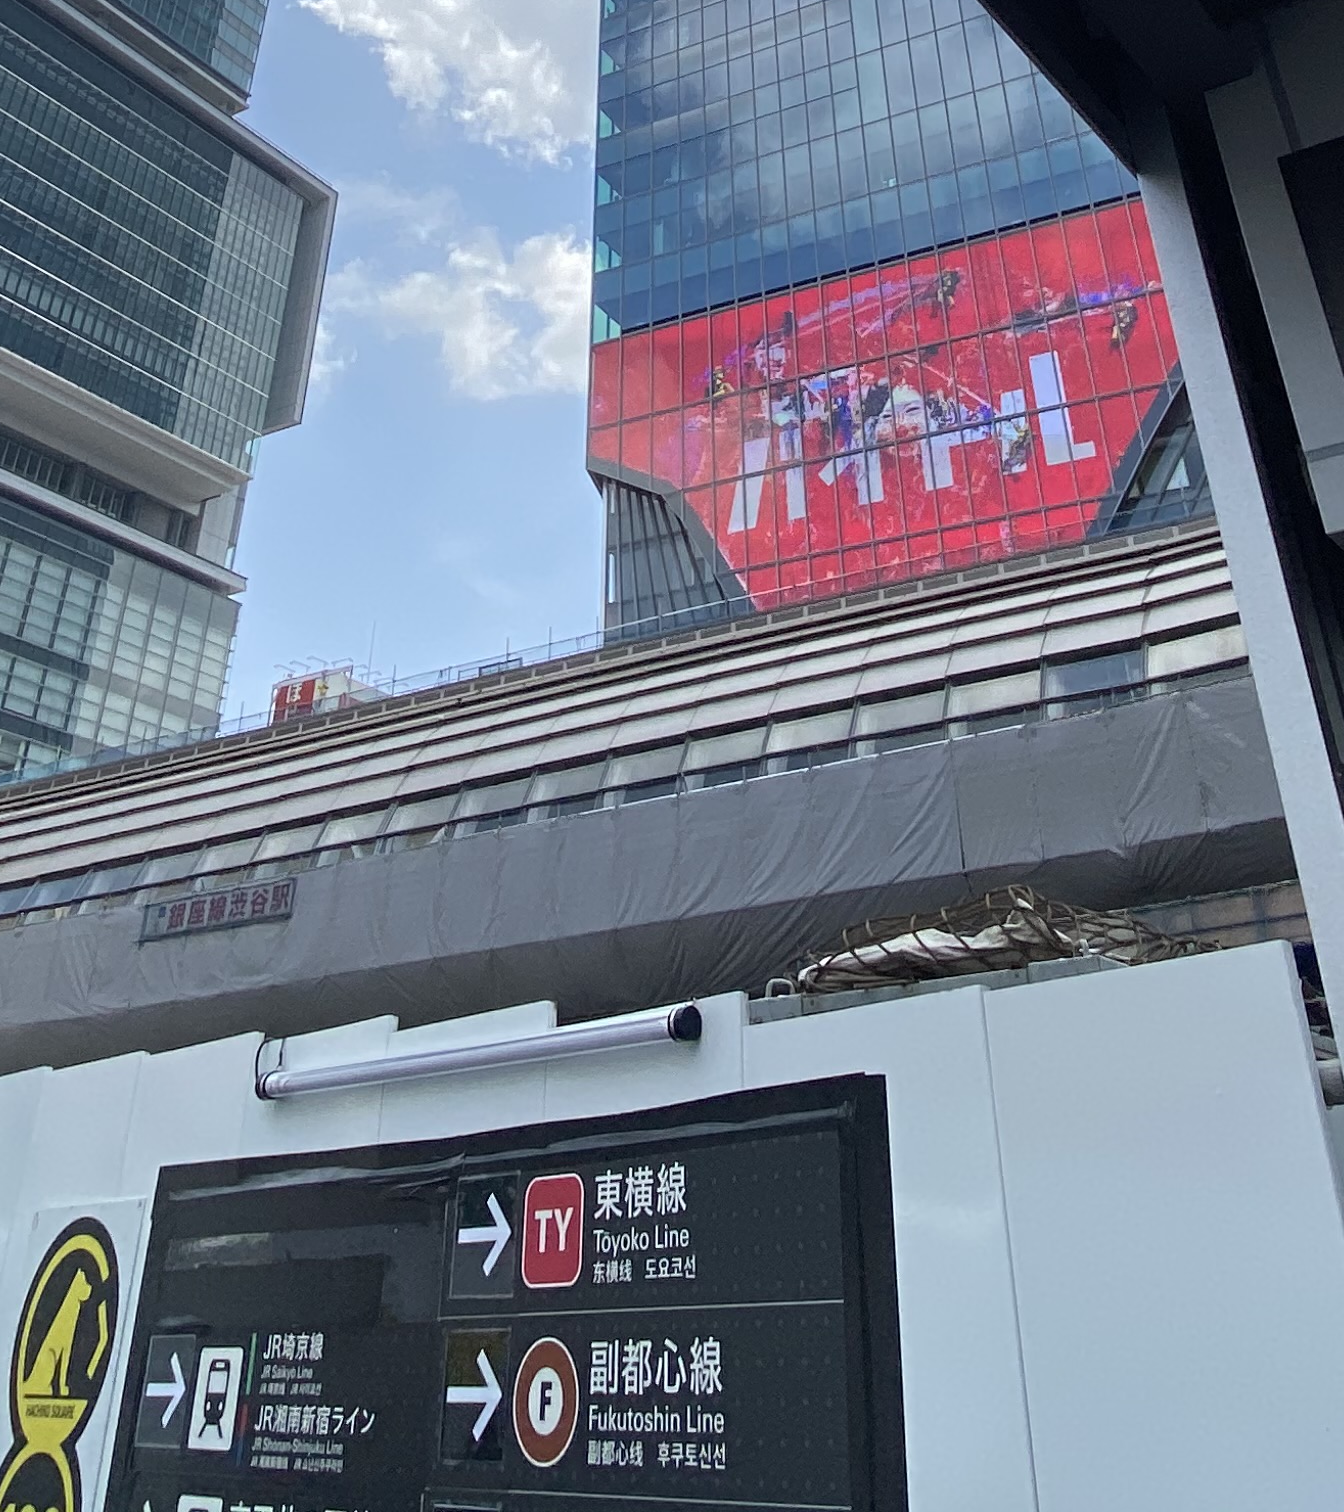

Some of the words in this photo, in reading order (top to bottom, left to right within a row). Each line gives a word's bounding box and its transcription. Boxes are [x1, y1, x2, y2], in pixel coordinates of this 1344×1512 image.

[593, 1161, 688, 1221] 東横線
[534, 1207, 574, 1253] TY
[654, 1223, 690, 1250] Line
[644, 1254, 697, 1280] 도요코선
[262, 1331, 325, 1362] JR埼京線
[589, 1336, 723, 1396] 副都心線
[539, 1381, 553, 1422] F
[254, 1403, 376, 1436] JR湘南新宿ライン
[588, 1404, 681, 1433] Fukutoshin
[686, 1404, 725, 1434] Line
[657, 1441, 727, 1470] 후쿠토신선
